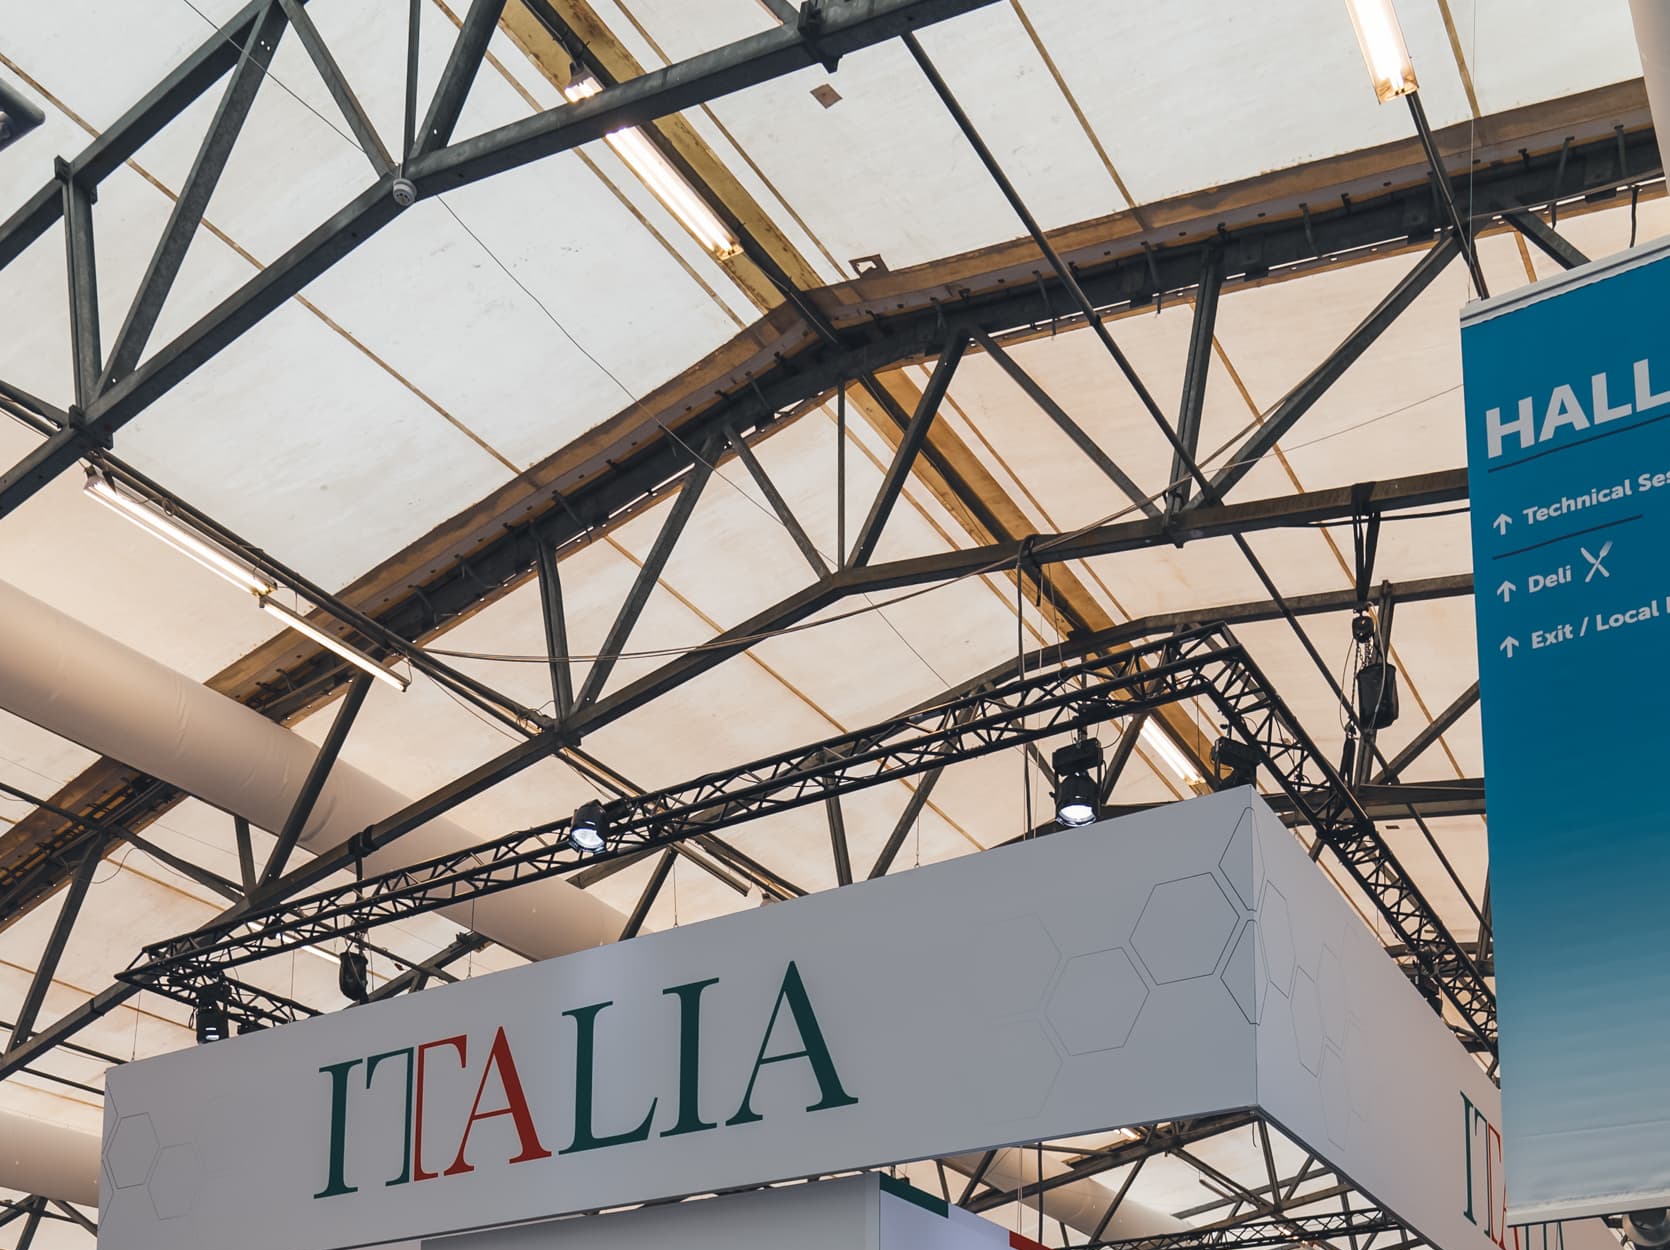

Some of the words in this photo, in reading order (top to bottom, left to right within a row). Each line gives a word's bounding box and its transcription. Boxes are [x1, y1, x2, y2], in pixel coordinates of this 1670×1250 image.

[1486, 358, 1670, 459] HALL
[1522, 479, 1632, 525] Technical
[1528, 565, 1572, 593] Deli
[1531, 624, 1573, 649] Exit
[1596, 600, 1659, 631] Local
[313, 960, 858, 1199] ITALIA
